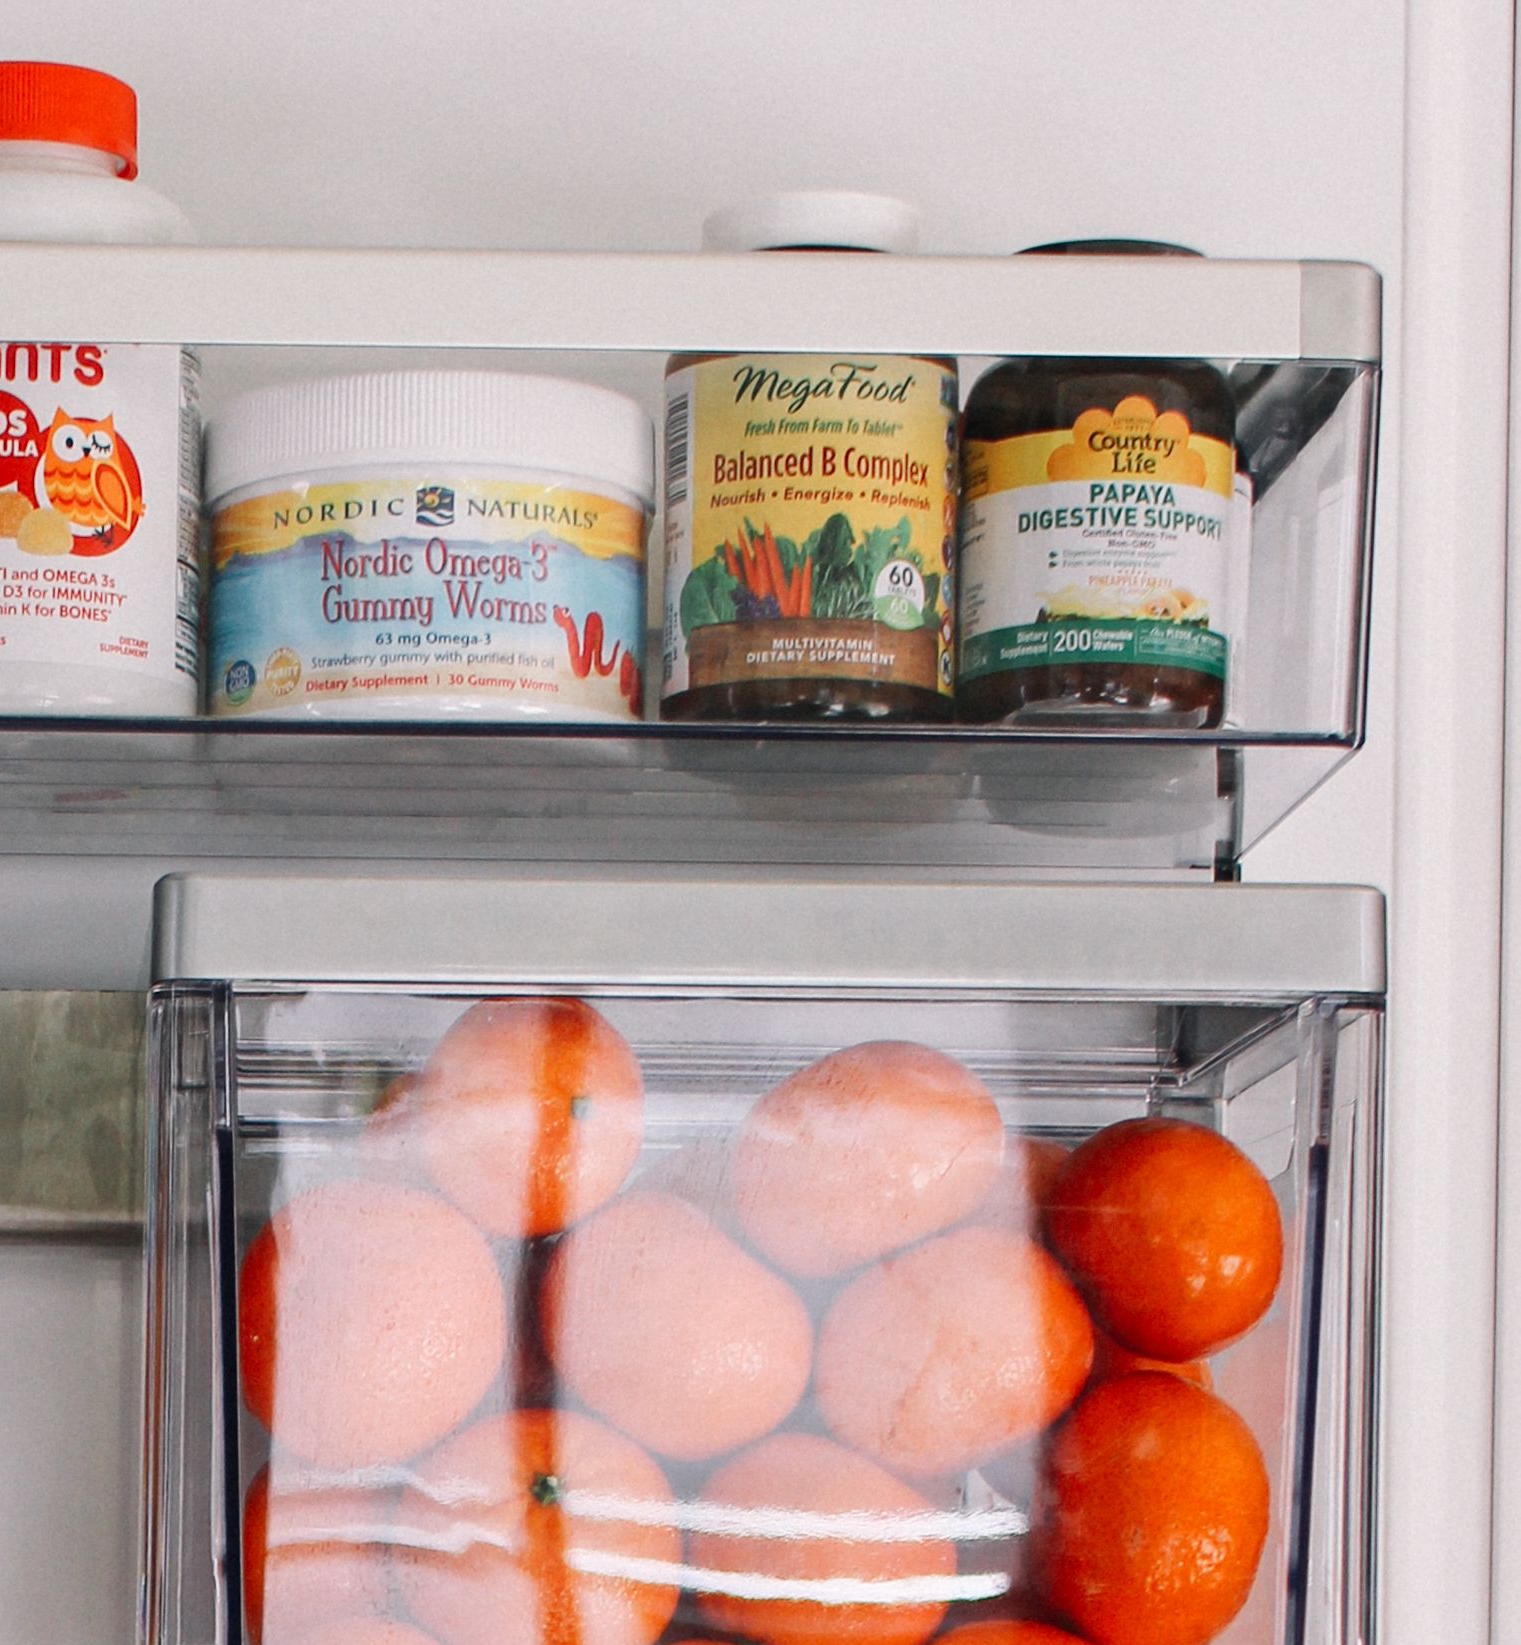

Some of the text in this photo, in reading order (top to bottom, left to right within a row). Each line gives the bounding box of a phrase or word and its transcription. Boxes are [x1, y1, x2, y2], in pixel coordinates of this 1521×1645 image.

[1088, 430, 1176, 458] Country
[714, 447, 928, 487] Balanced B Complex
[1111, 451, 1156, 474] Life
[710, 487, 931, 512] Nourish Energize Replenish
[1089, 484, 1176, 505] PAPAYA
[273, 498, 404, 530] NORDIC
[1018, 507, 1222, 540] DIGESTIVE SUPPORT
[321, 537, 548, 584] Nordic Omega-3
[43, 569, 96, 586] OMEGA
[890, 566, 913, 587] 60
[321, 580, 547, 626] Gummy Worms
[398, 632, 492, 648] mg Omega-3
[772, 638, 873, 650] MULTIVITAMIN
[1053, 629, 1091, 652] 200
[311, 651, 462, 670] Strawberry with
[746, 651, 895, 665] DIETARY SUPPLEMENT
[306, 673, 515, 694] Dietary Supplement 30 Gummy
